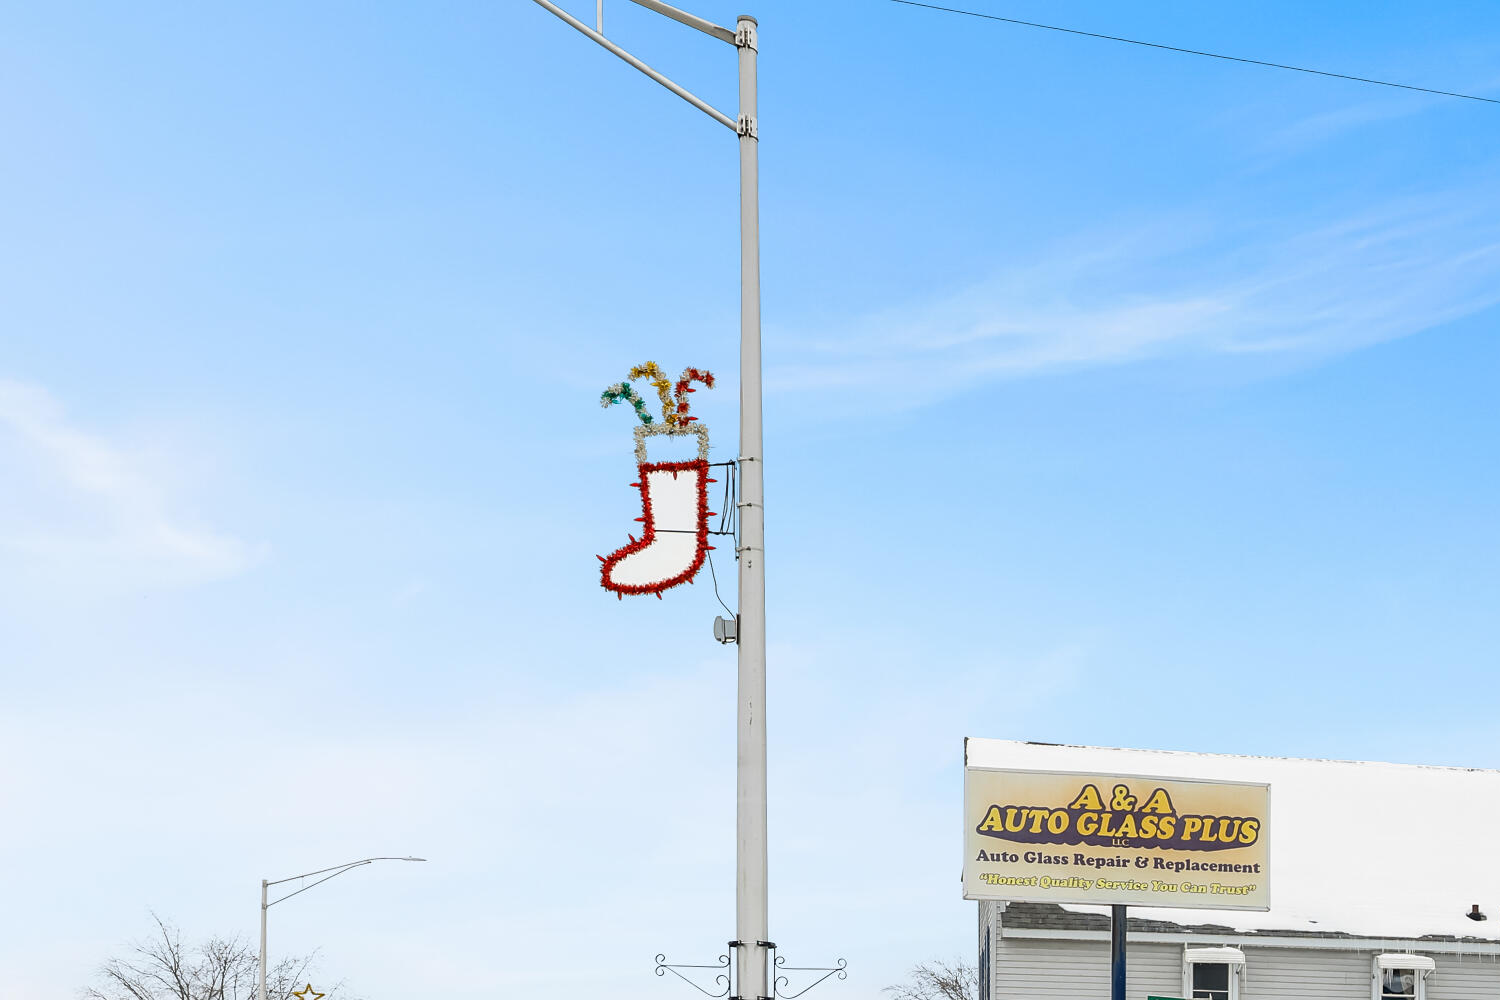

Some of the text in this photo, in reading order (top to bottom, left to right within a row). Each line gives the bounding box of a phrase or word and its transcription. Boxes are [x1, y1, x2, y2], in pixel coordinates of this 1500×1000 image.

[1070, 785, 1173, 814] A & A
[979, 806, 1260, 844] AUTO GLASS PLUS
[1112, 838, 1130, 847] LLC
[976, 849, 1261, 873] Auto Glass Repair & Replacement
[1040, 875, 1094, 891] Quality
[1096, 878, 1148, 891] Service
[1151, 880, 1178, 893] You
[1180, 882, 1208, 893] Can
